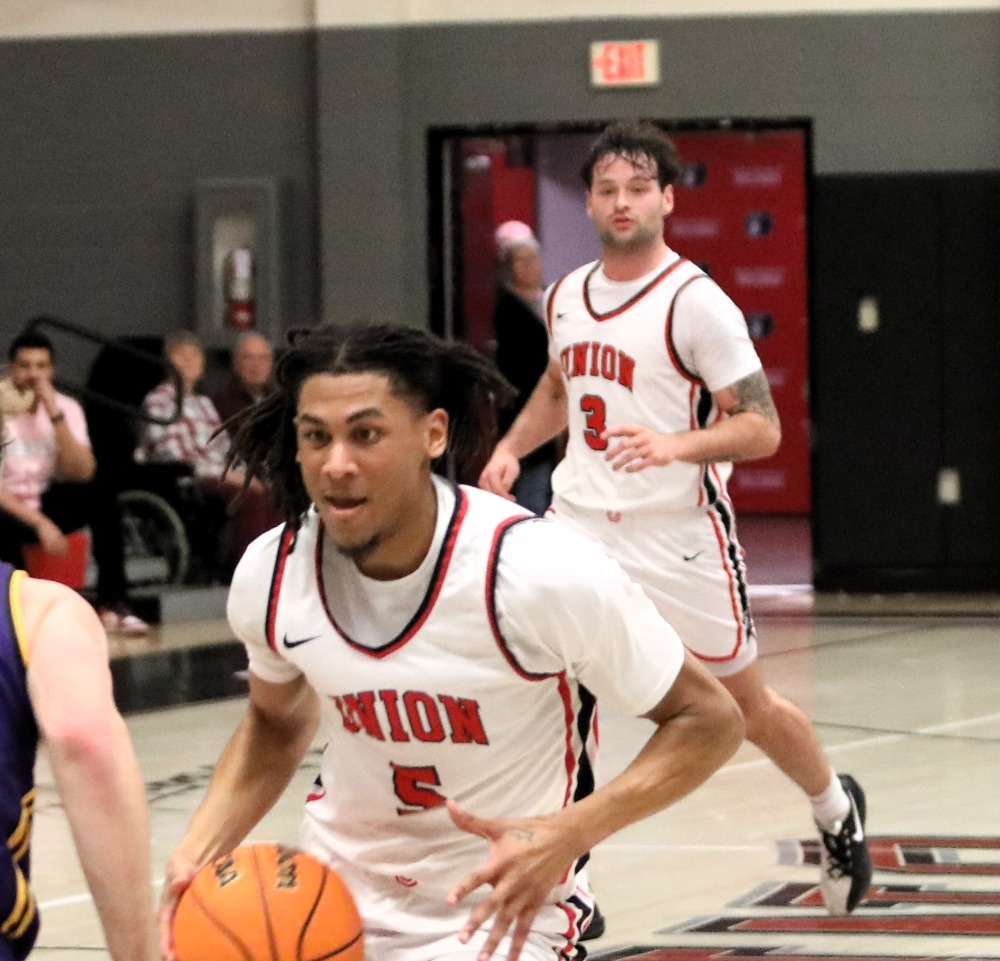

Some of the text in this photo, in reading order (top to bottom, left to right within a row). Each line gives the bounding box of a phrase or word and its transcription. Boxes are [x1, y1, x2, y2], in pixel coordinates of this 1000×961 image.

[603, 42, 646, 81] EXIT
[580, 393, 608, 451] 3
[389, 760, 447, 817] 5
